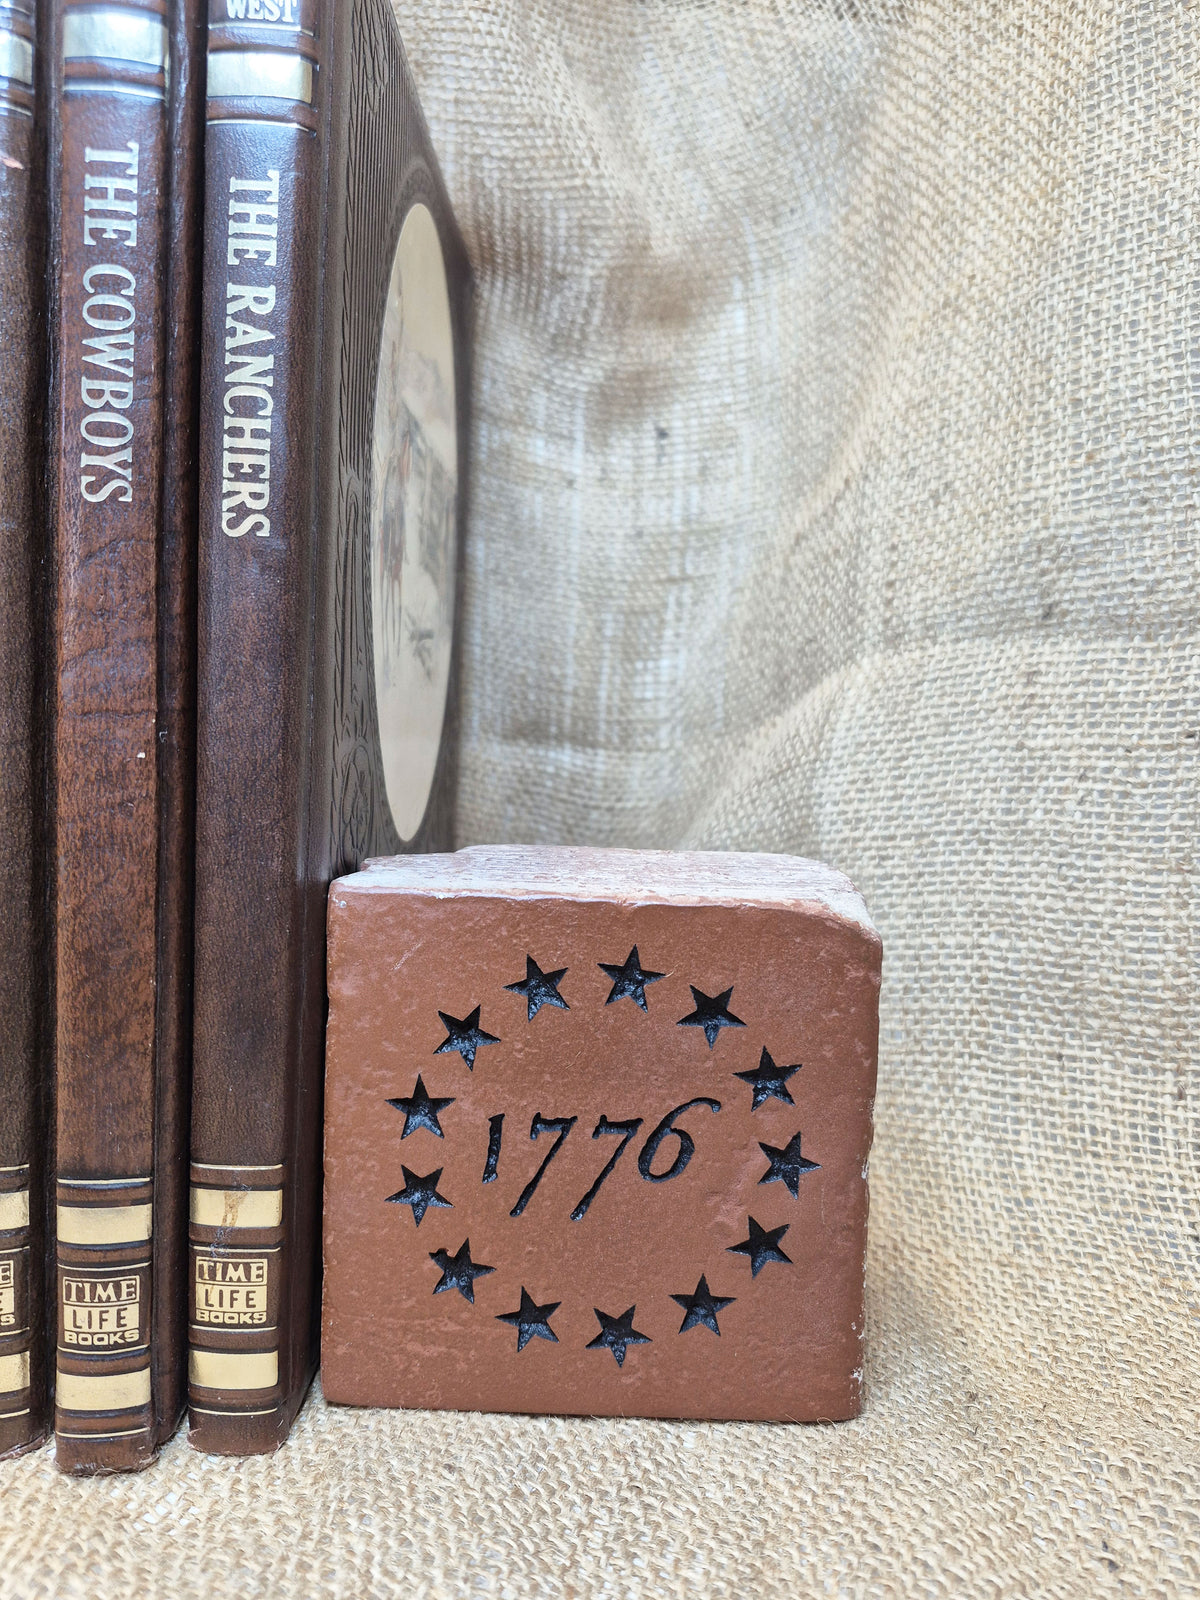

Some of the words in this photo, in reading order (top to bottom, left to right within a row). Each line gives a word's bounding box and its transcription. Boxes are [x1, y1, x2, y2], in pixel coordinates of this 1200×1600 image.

[226, 0, 297, 22] WEST
[83, 141, 139, 247] THE
[227, 169, 280, 267] THE
[80, 263, 137, 503] COWBOYS
[221, 282, 277, 538] RANCHERS
[482, 1097, 721, 1222] 1776
[198, 1261, 264, 1282] TIME
[65, 1280, 136, 1303] TIME
[204, 1288, 257, 1309] LIFE
[72, 1307, 128, 1330] LIFE
[196, 1309, 267, 1324] BOOKS
[64, 1329, 139, 1346] BOOKS
